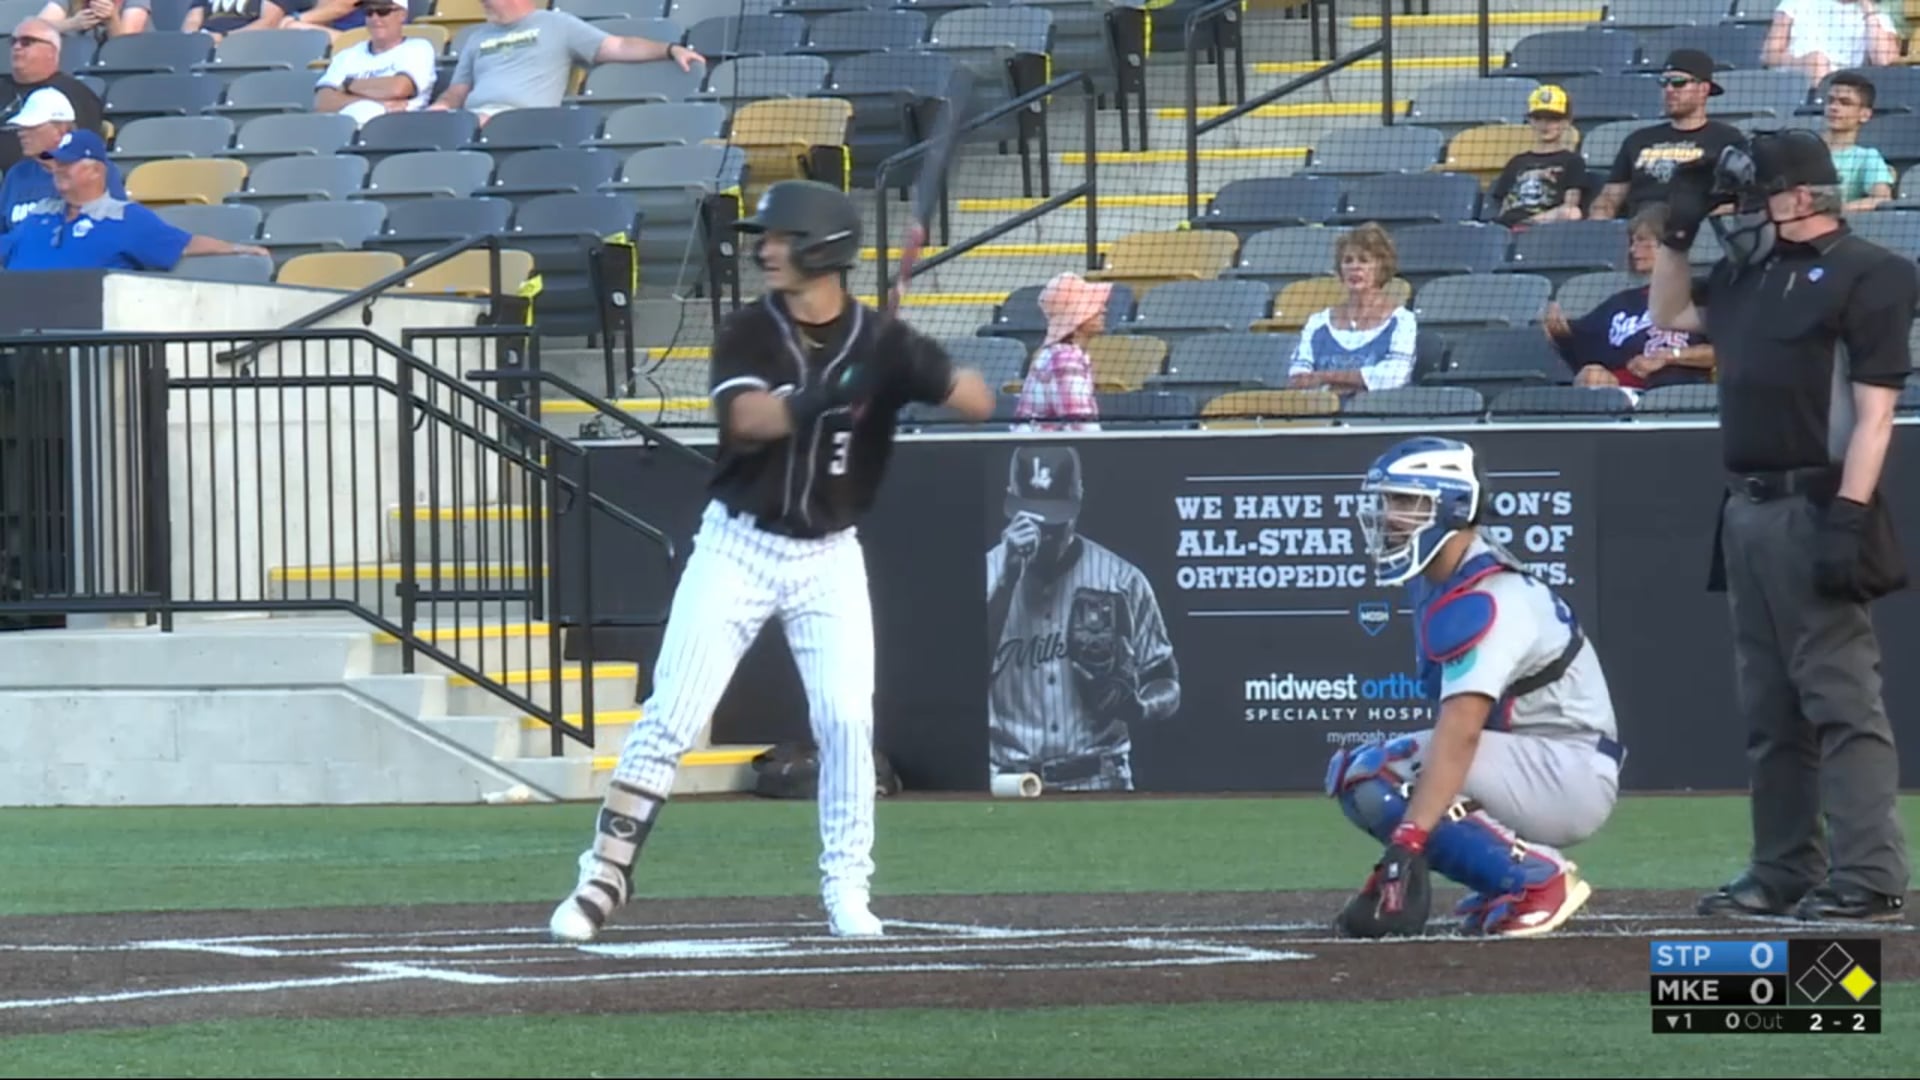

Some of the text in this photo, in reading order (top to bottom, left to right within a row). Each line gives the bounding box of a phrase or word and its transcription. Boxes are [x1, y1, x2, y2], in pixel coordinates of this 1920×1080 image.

[828, 431, 851, 475] 3
[1175, 491, 1573, 520] WE HAVE TH ON'S
[1176, 528, 1353, 557] ALL-STAR
[1524, 525, 1574, 553] OF
[1176, 564, 1367, 589] ORTHOPEDIC
[1245, 672, 1428, 701] midwest ortho
[1245, 706, 1433, 721] SPECIALTY HOSPI
